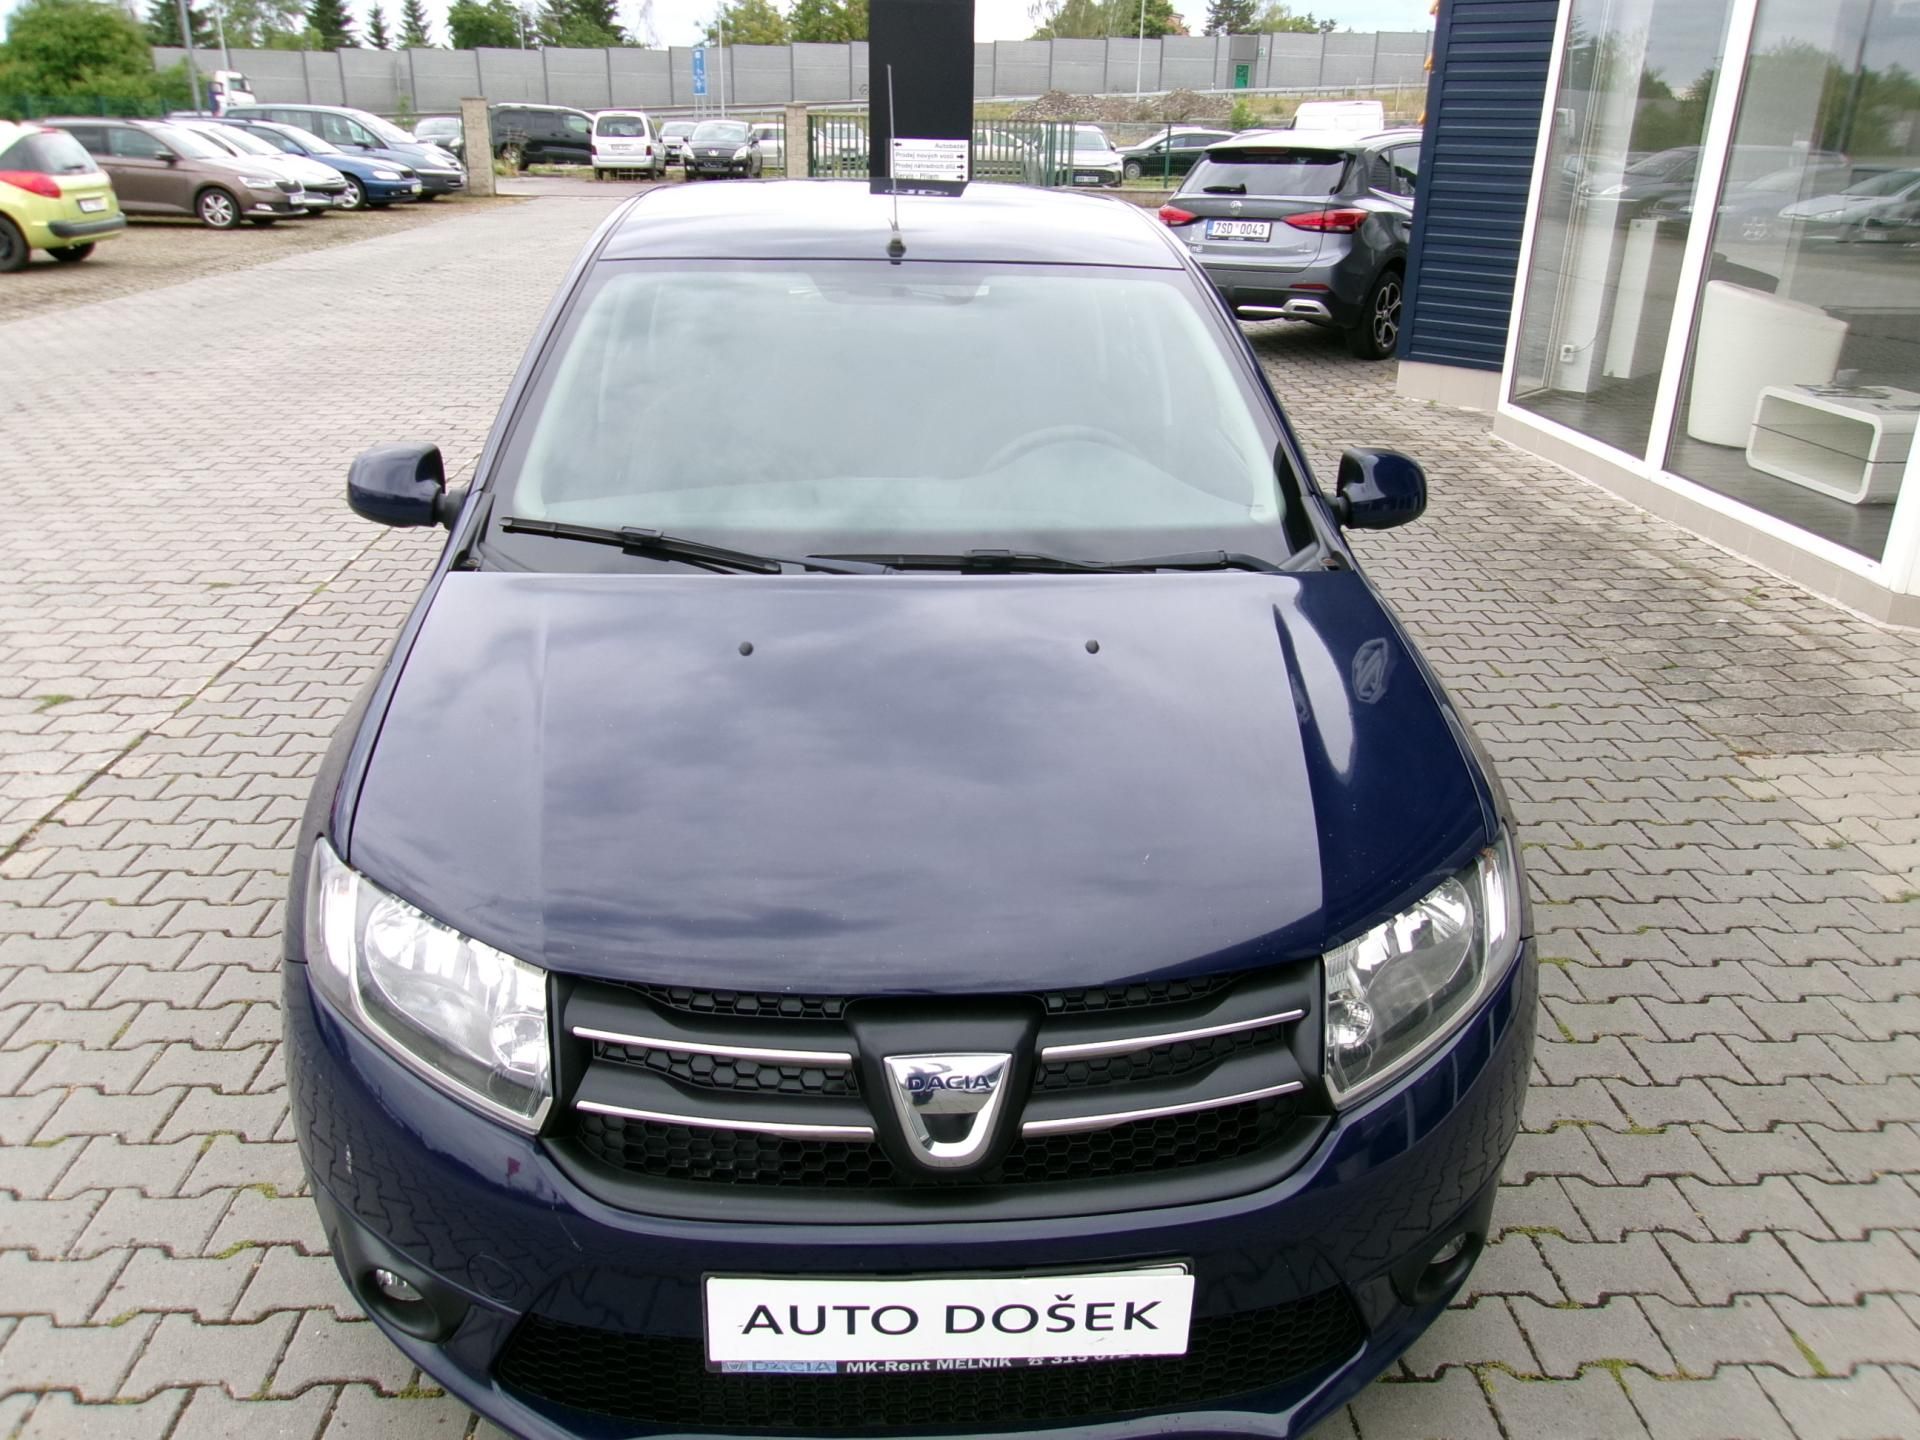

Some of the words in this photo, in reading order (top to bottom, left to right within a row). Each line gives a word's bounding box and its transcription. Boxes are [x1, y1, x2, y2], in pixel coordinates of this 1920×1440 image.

[1215, 223, 1233, 234] 7SD
[1240, 223, 1265, 235] 0043
[908, 1075, 991, 1090] DACIA
[741, 1304, 919, 1336] AUTO
[945, 1294, 1162, 1334] DOŠEK
[752, 1361, 833, 1372] DACIA
[846, 1360, 931, 1373] MK-Rent
